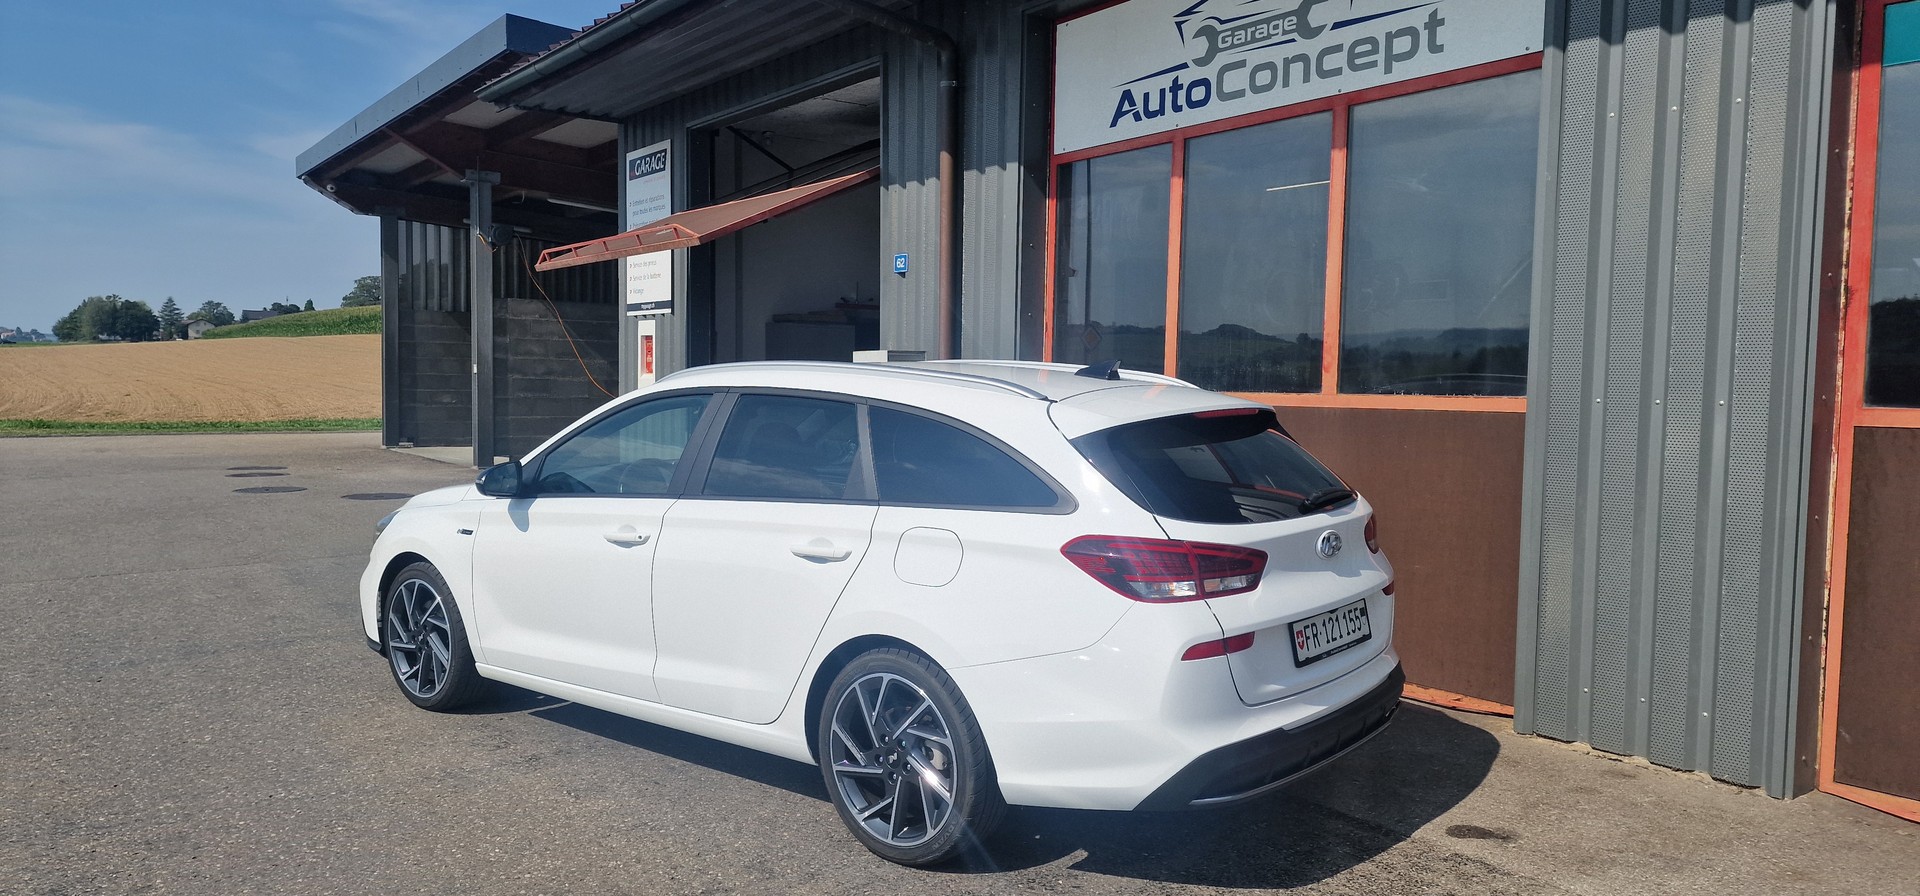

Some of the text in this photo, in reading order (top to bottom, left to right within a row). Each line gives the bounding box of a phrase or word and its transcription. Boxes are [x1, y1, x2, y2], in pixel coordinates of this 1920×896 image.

[1217, 15, 1298, 48] Garage
[1109, 8, 1446, 128] AutoConcept
[635, 152, 665, 175] GARAGE
[897, 257, 905, 268] 62
